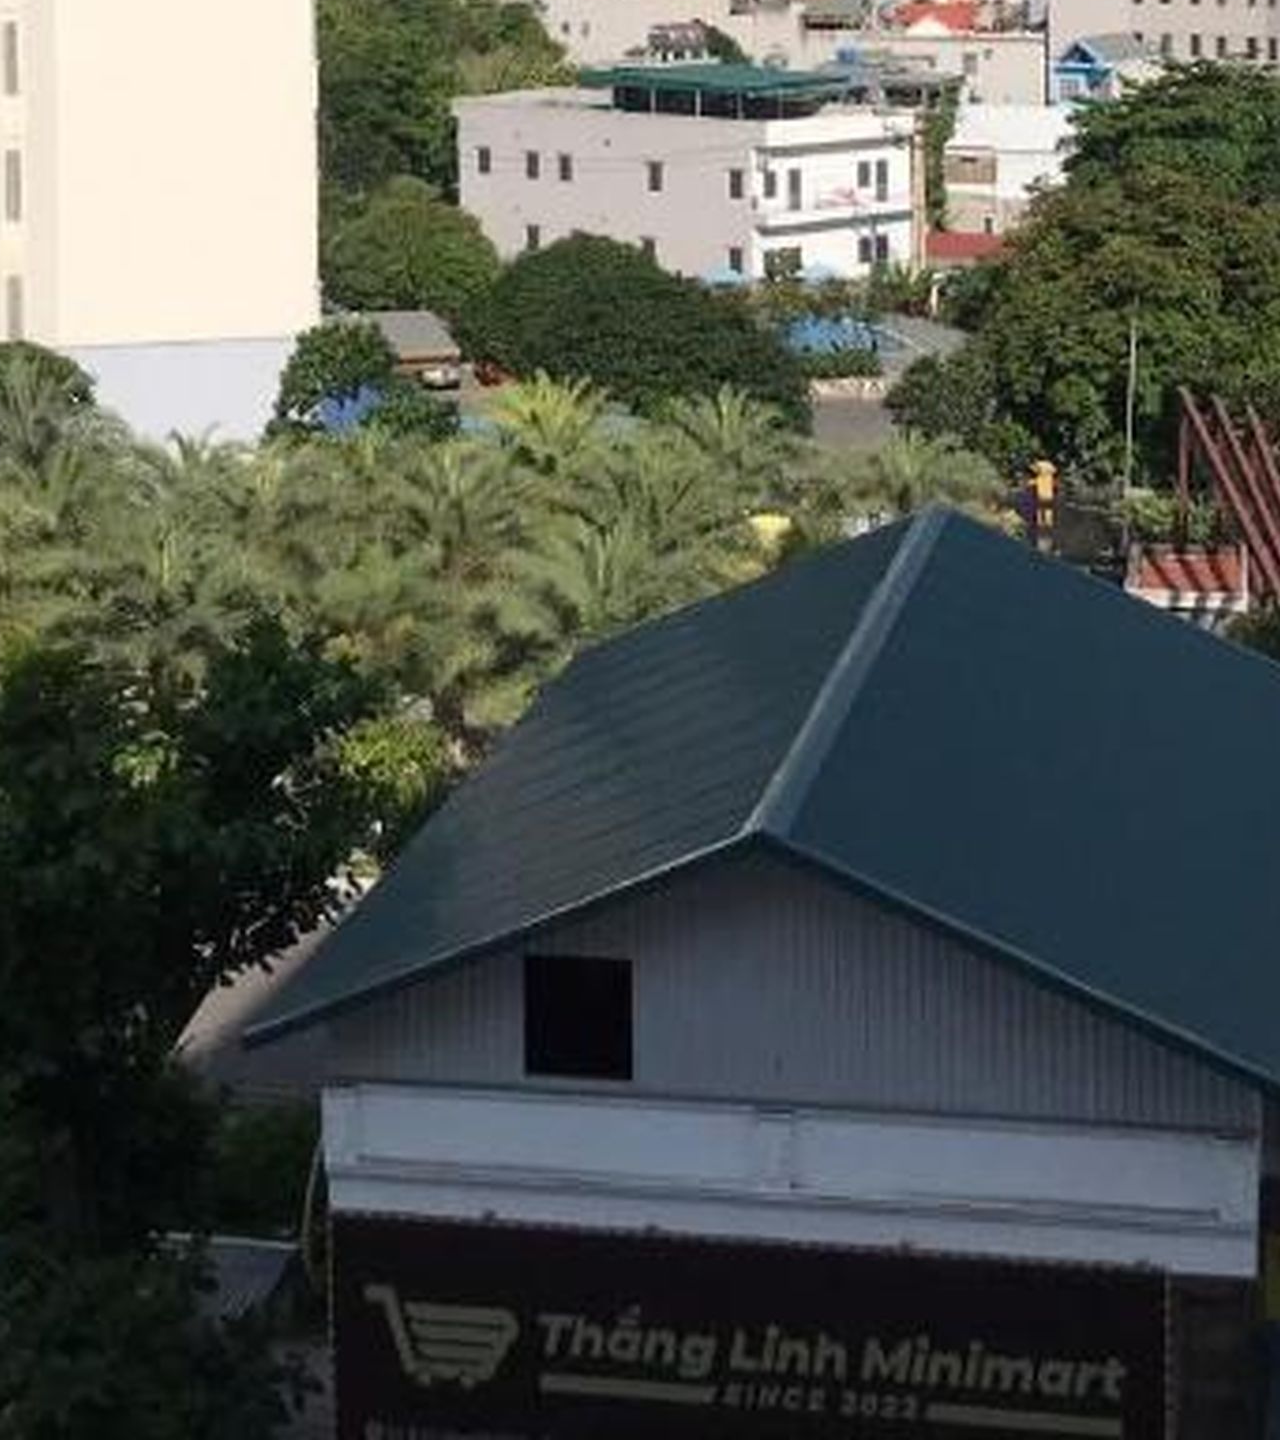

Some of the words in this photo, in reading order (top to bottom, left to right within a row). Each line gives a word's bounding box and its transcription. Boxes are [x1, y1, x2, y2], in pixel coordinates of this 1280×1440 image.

[535, 1304, 718, 1378] Thắng
[729, 1325, 848, 1381] Linh
[860, 1334, 1129, 1400] Minimart
[722, 1380, 826, 1411] SINCE
